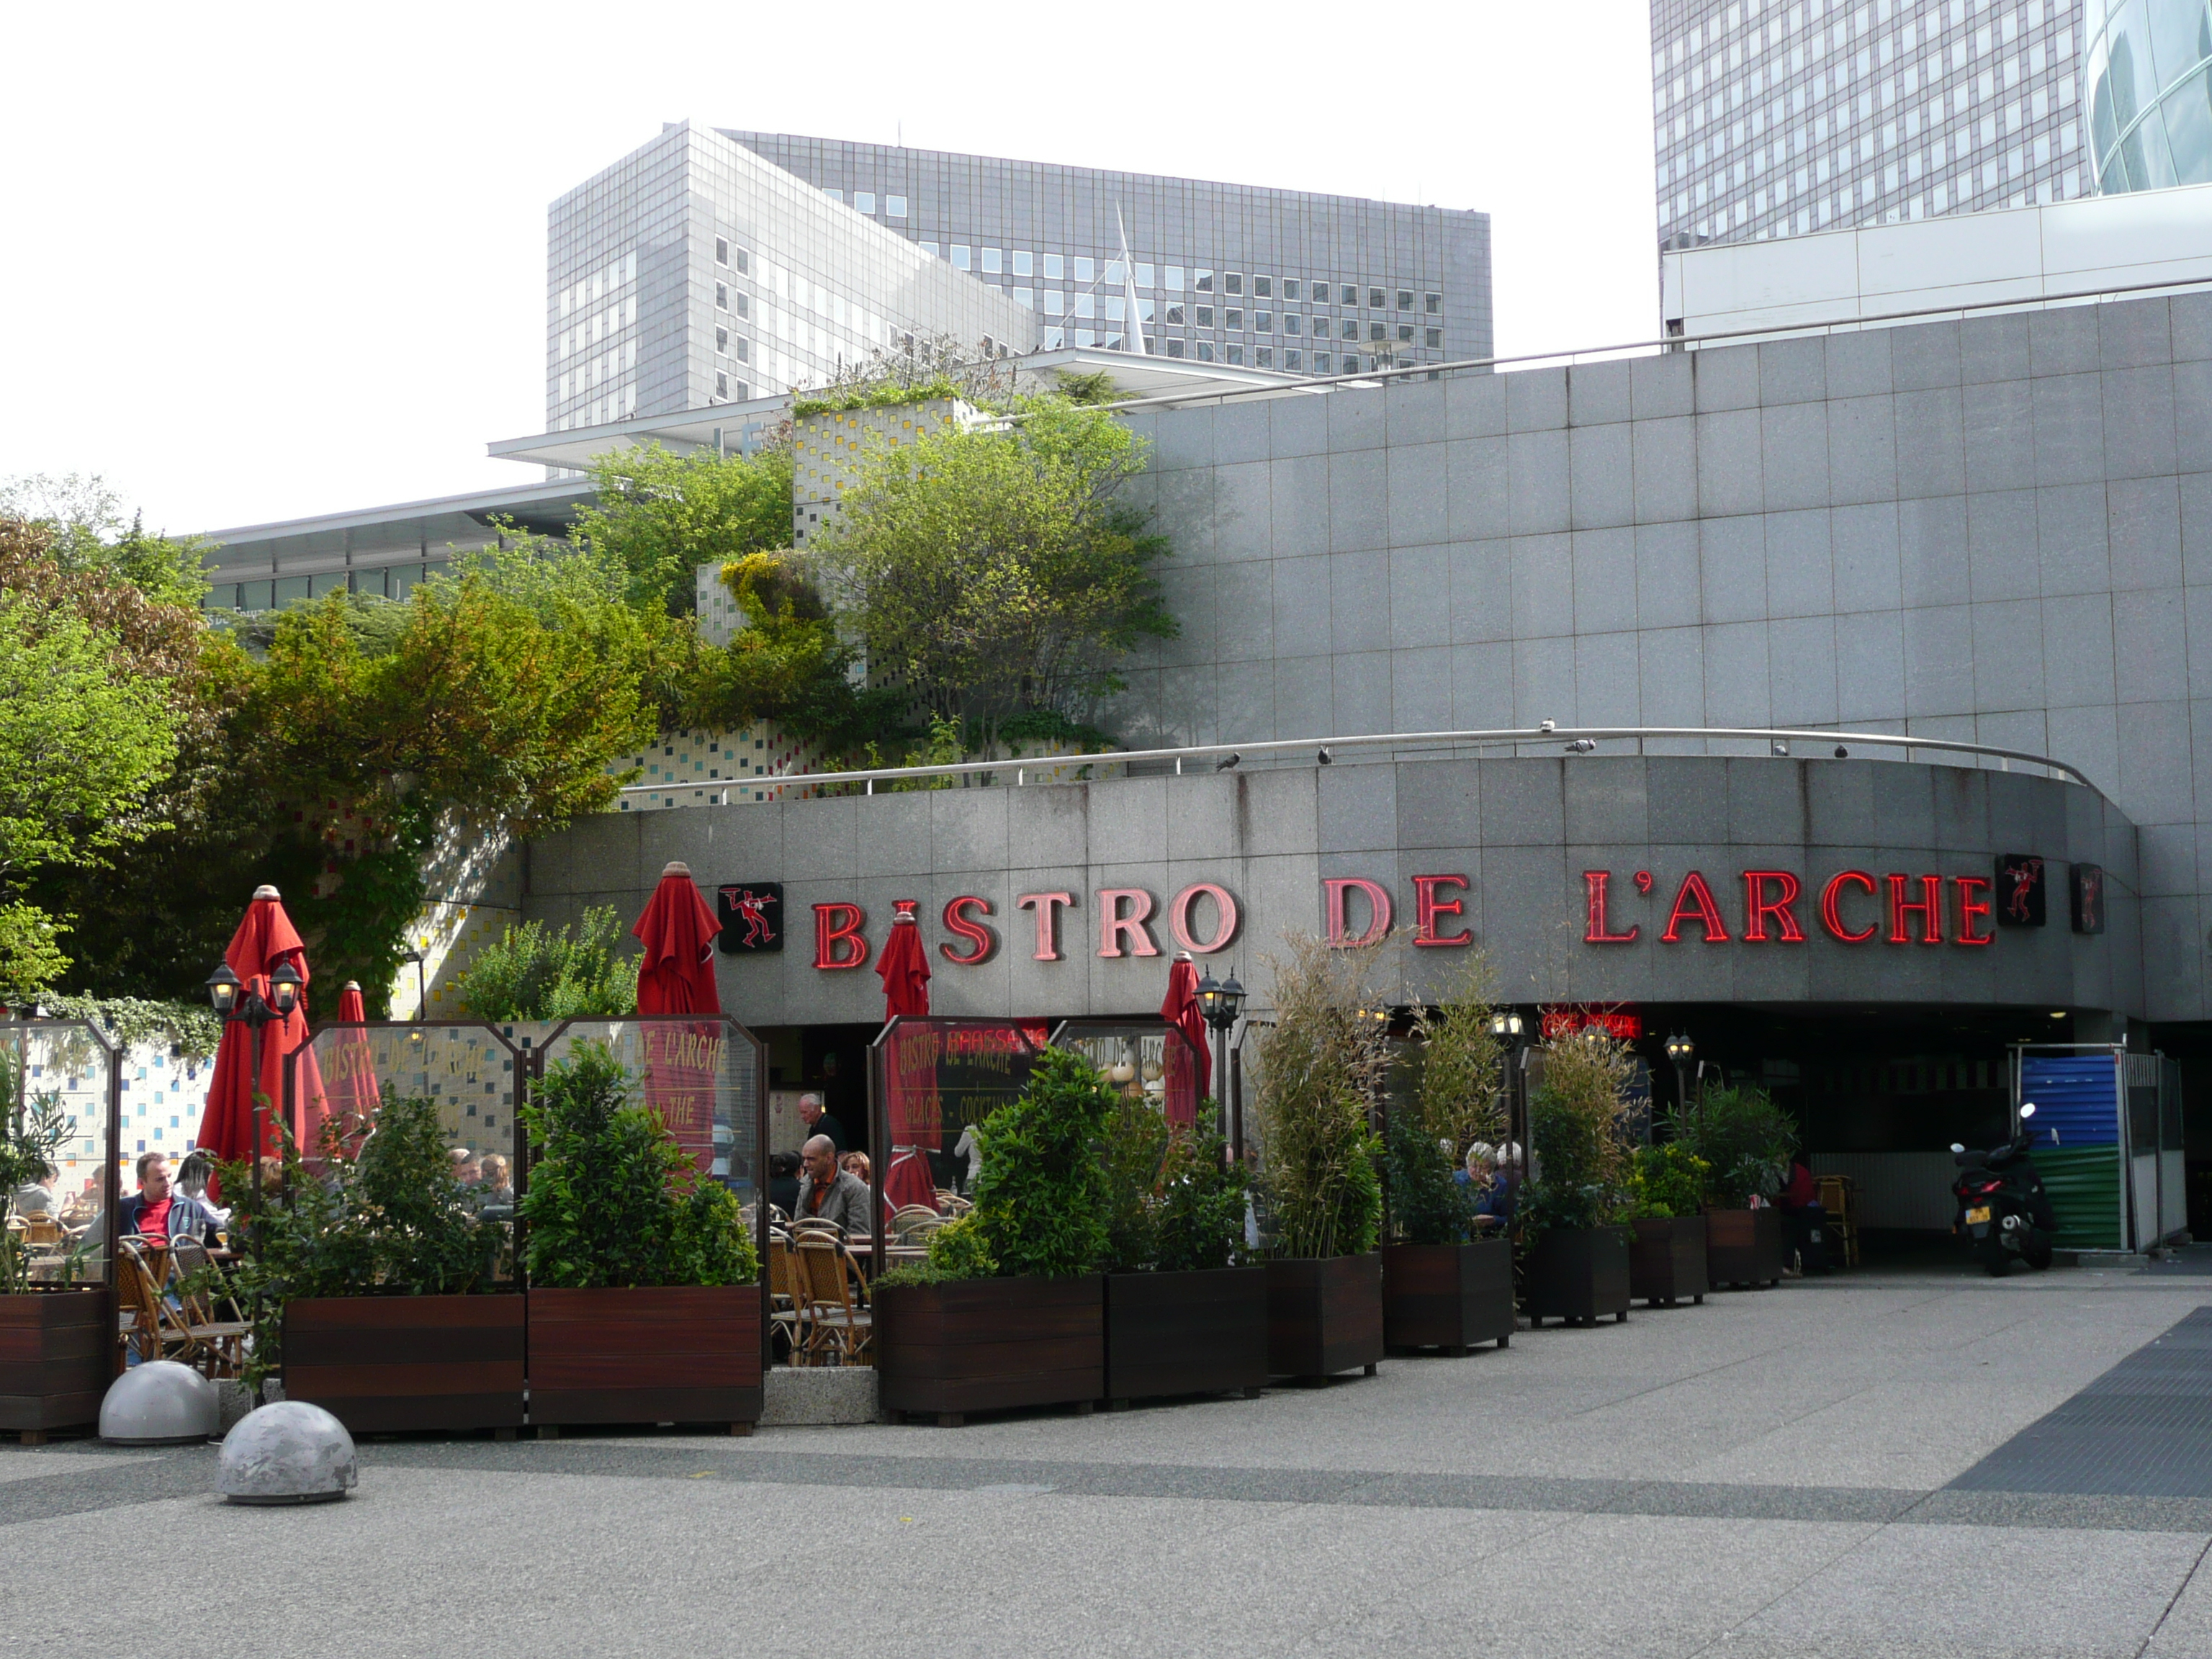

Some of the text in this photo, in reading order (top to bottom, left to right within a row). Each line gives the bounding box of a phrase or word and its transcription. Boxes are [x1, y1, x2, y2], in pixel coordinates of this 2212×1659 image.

[811, 868, 1995, 969] BSTRO DE L'ARCHE
[323, 1037, 487, 1085] BISTRO DE LARCHE
[634, 1030, 655, 1065] DE
[665, 1031, 728, 1074] L'ARCHE
[899, 1033, 939, 1076] BISTRO
[1114, 1035, 1128, 1067] DE
[906, 1095, 944, 1125] GLACES
[960, 1095, 1012, 1124] COCKT
